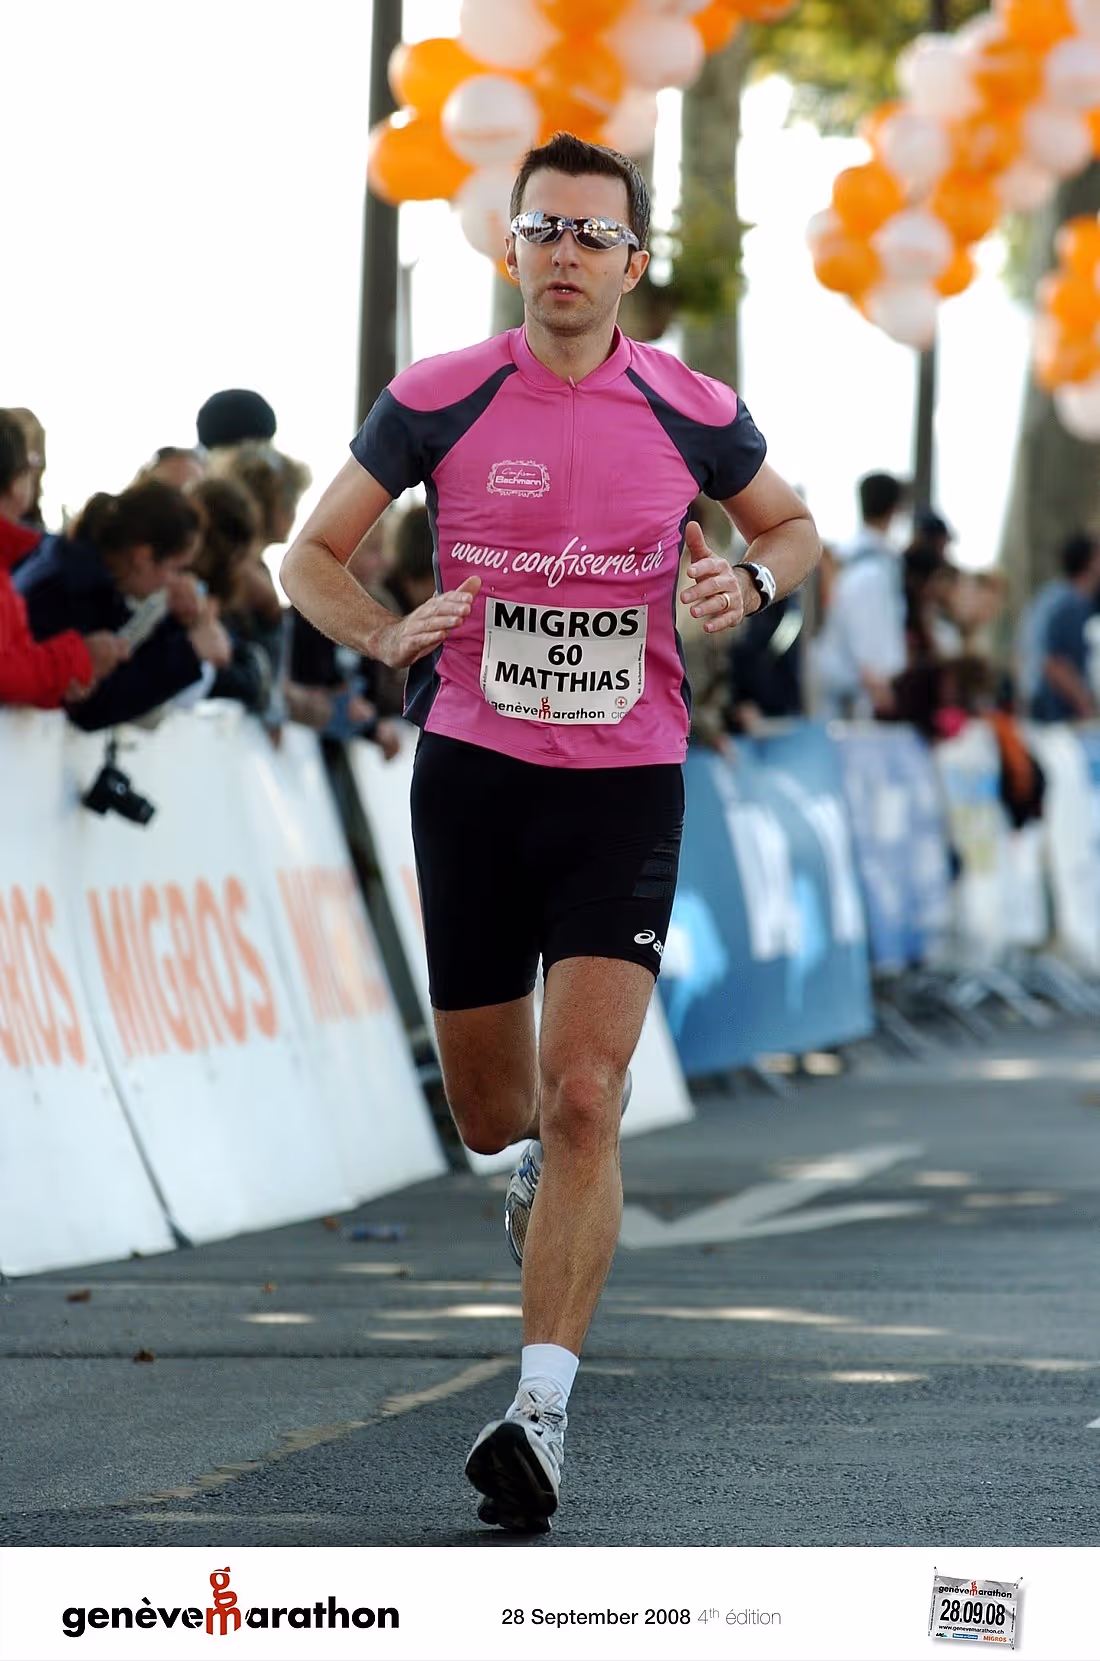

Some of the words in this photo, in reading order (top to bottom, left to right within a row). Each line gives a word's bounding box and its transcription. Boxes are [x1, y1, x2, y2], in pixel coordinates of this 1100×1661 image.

[495, 475, 541, 486] Bachmann
[450, 536, 664, 588] www.confiserie.ch
[494, 601, 640, 638] MIGROS
[547, 644, 583, 666] 60
[495, 660, 630, 693] MATTHIAS
[86, 873, 279, 1058] MIGROS
